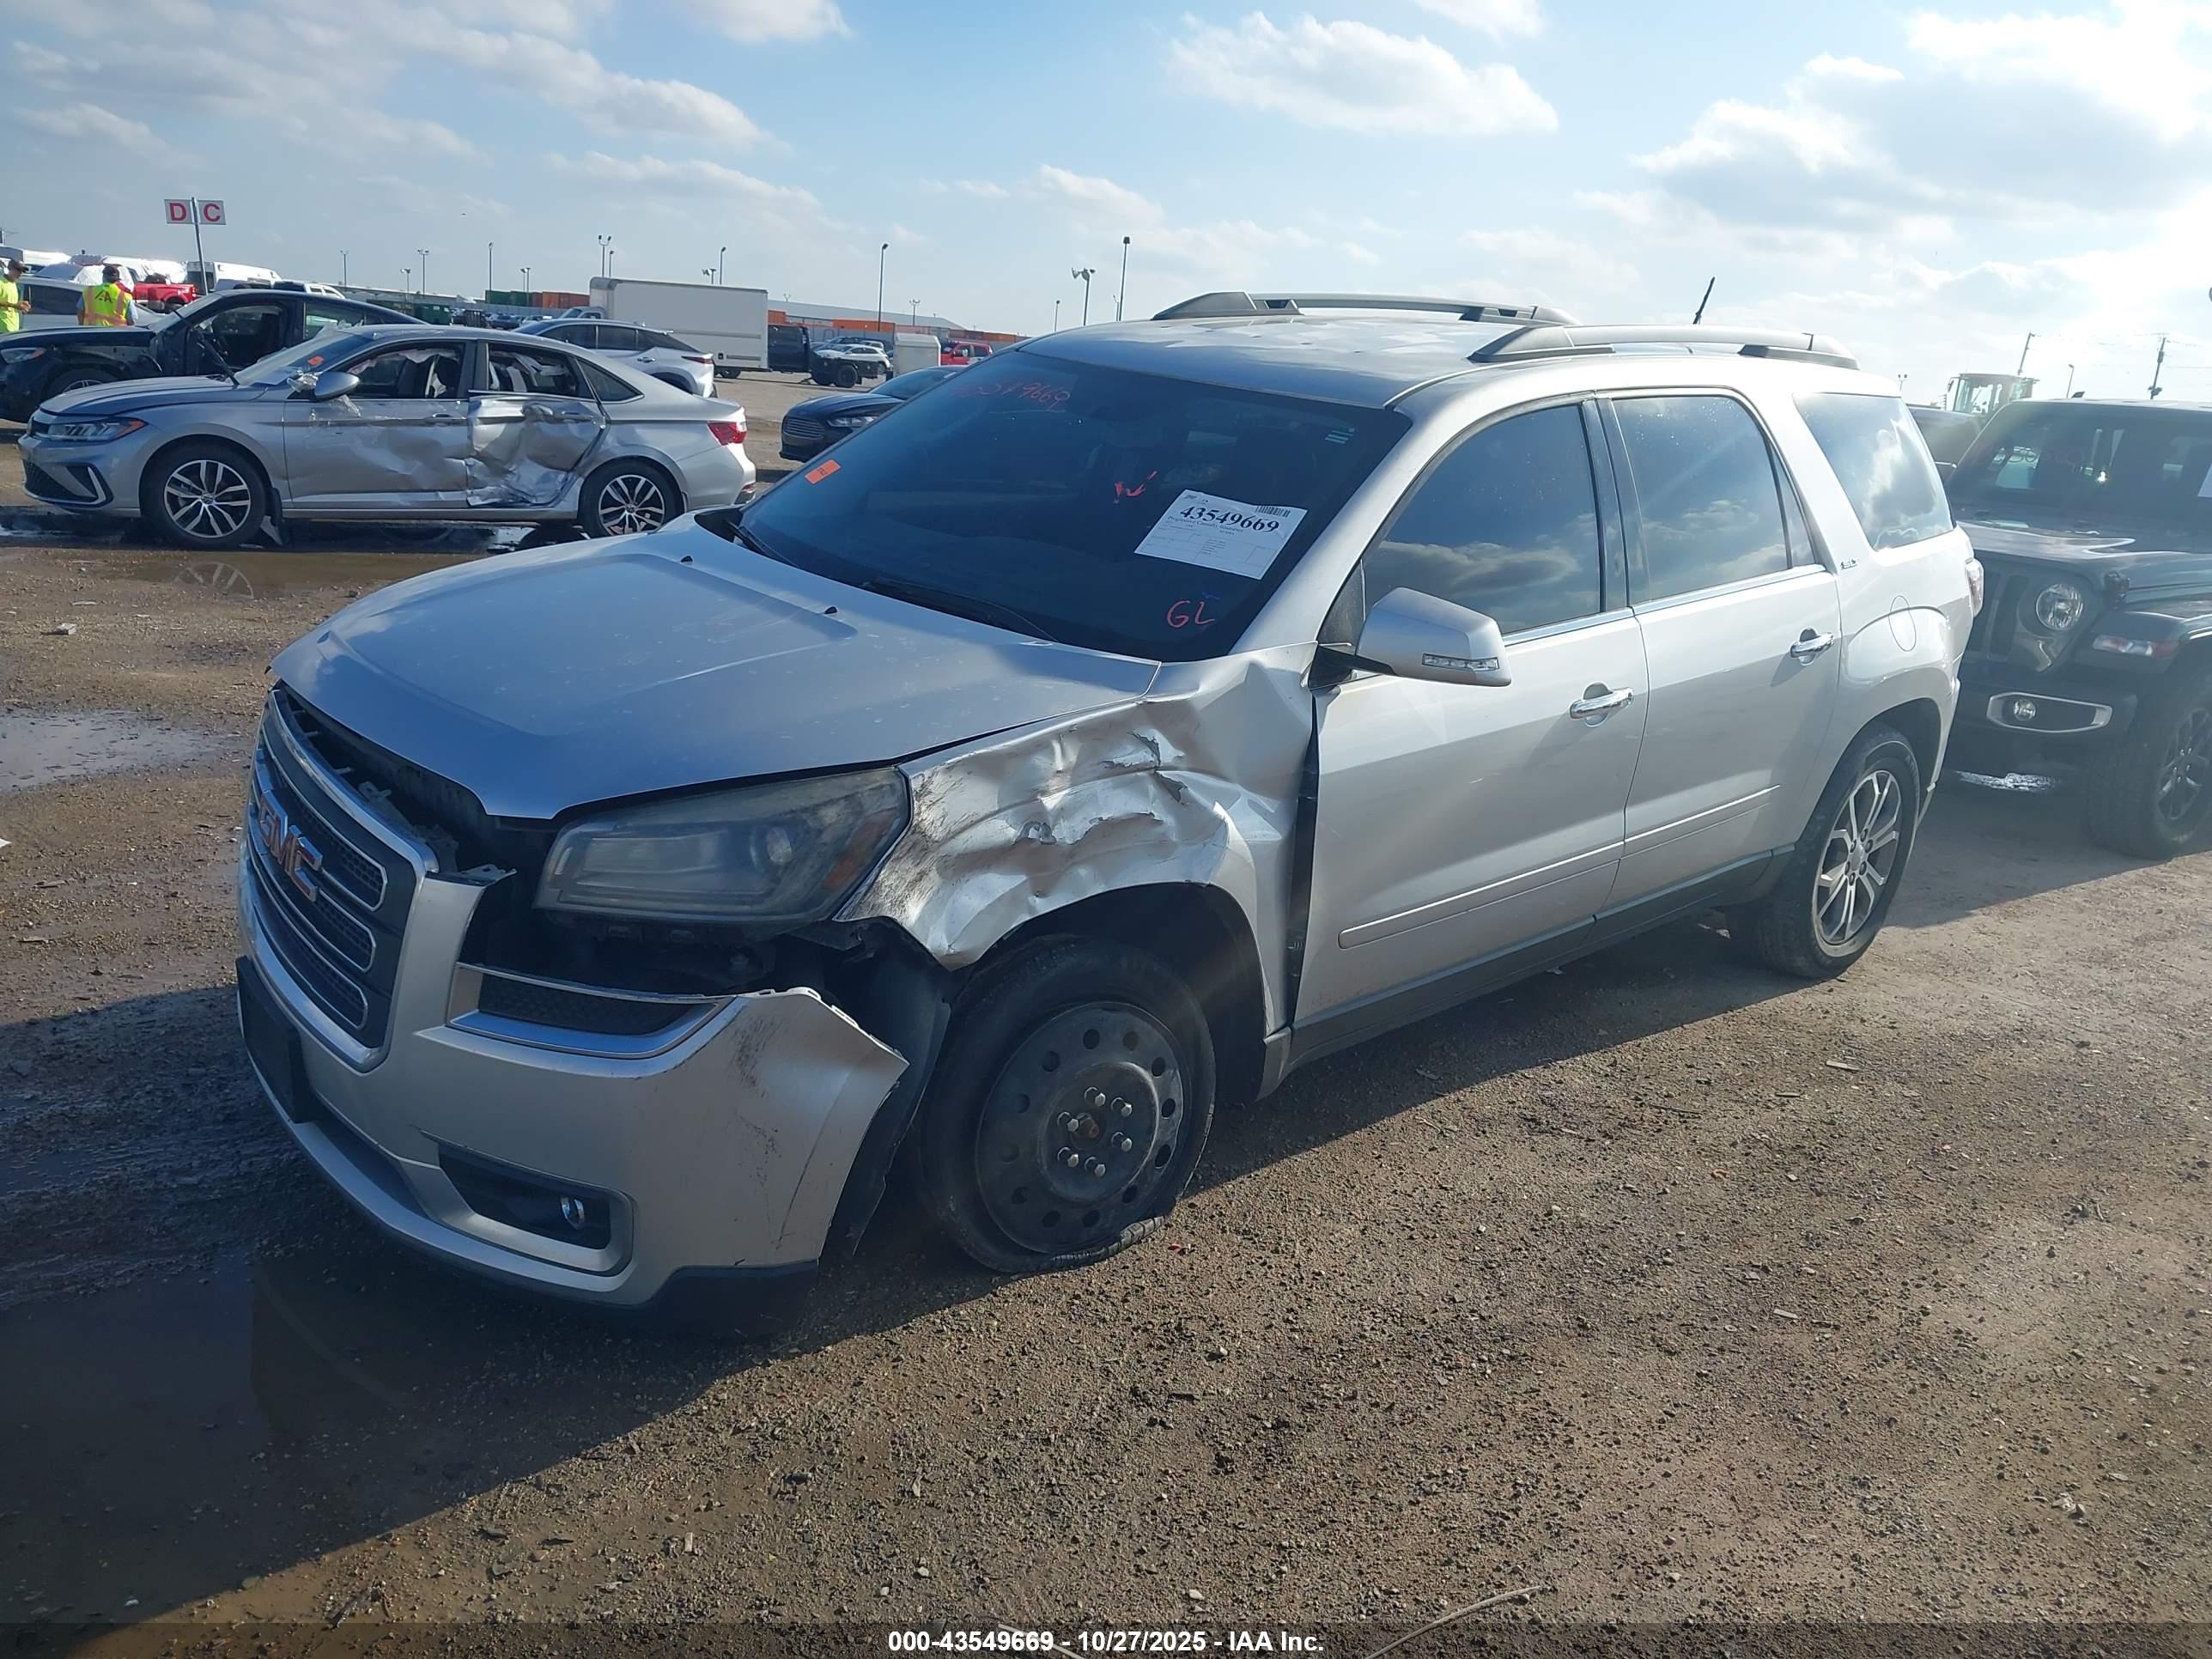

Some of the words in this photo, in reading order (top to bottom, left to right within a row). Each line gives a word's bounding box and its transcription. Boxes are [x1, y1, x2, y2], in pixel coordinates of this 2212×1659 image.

[169, 203, 186, 221] D
[204, 203, 221, 222] C
[1180, 506, 1280, 533] 43549669
[260, 789, 323, 902] GMC
